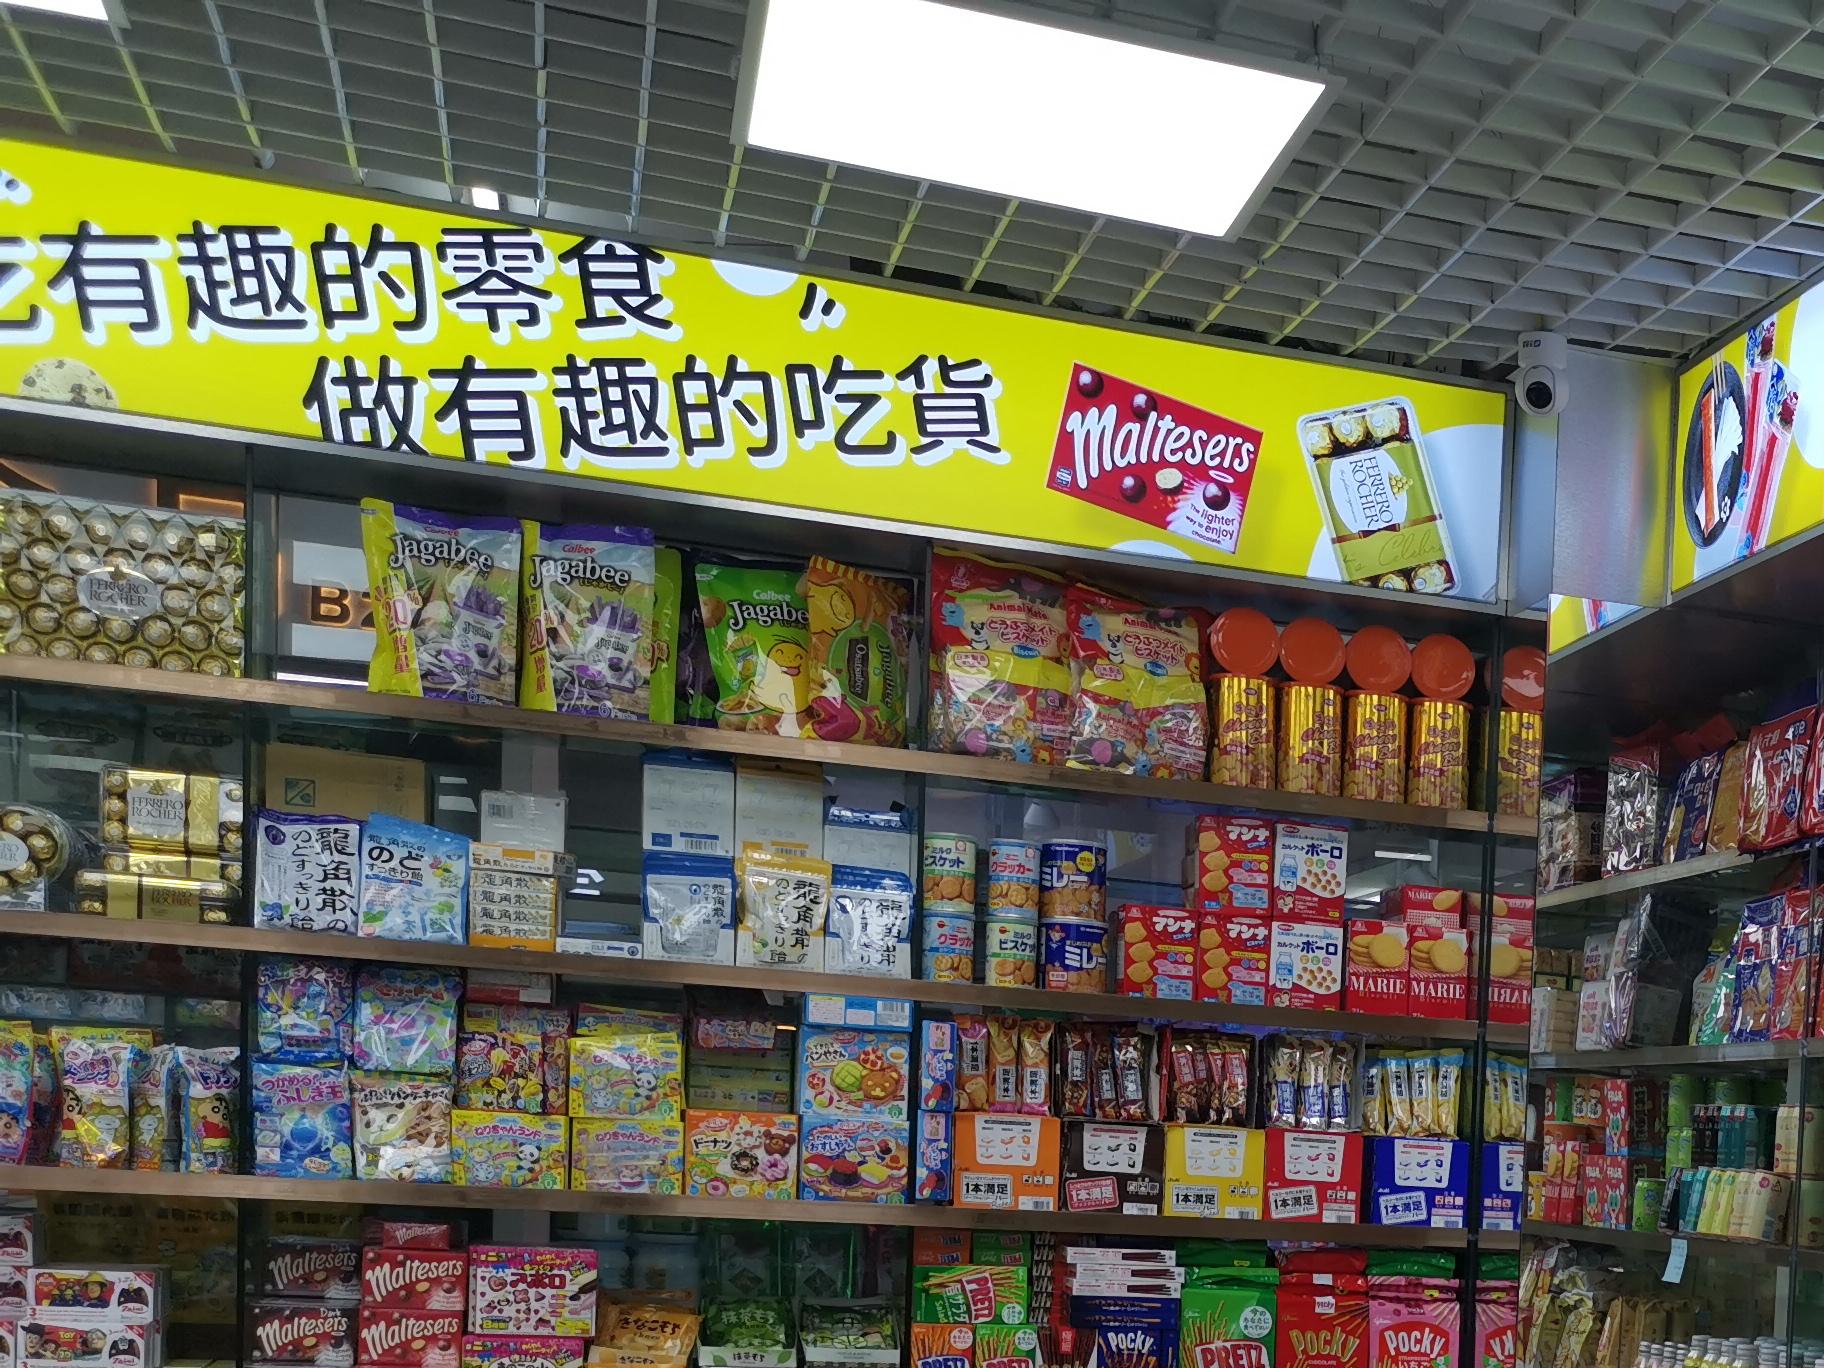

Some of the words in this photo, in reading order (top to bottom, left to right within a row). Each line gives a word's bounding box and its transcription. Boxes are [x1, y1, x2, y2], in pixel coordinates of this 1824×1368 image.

[303, 352, 1001, 464] 做有趣的吃貨
[1066, 404, 1255, 488] Maltesers
[1350, 462, 1380, 529] ROCHER
[1363, 456, 1394, 524] FERRERO
[1201, 509, 1236, 526] lighter
[1205, 523, 1234, 539] enjoy
[389, 532, 493, 572] Jagabee
[561, 543, 596, 555] Calbee
[530, 555, 630, 588] Jagabee
[752, 588, 791, 601] Calbee
[728, 599, 809, 632] Jagabe
[131, 797, 184, 811] FERRERO
[131, 806, 183, 820] ROCHER
[1226, 825, 1269, 840] マンナ
[368, 845, 425, 864] のど
[1306, 843, 1342, 859] ボーロ
[991, 861, 1033, 875] クラッカー
[1041, 865, 1089, 888] ミレー
[1153, 917, 1195, 932] マンナ
[1227, 923, 1269, 939] マンナ
[1301, 940, 1338, 955] ボーロ
[1350, 976, 1406, 996] MARIE
[1411, 980, 1465, 999] MARIE
[692, 1137, 733, 1150] ドーナツ
[963, 1183, 1011, 1196] 1本満足
[1173, 1190, 1217, 1205] 1本満足
[1271, 1195, 1317, 1211] 1本満足
[1383, 1198, 1425, 1214] 1本満足
[269, 1252, 358, 1289] Maltesers
[365, 1257, 464, 1301] Maltesers
[509, 1273, 567, 1289] アポロ
[964, 1273, 994, 1323] PRETZ
[257, 1313, 348, 1353] Maltesers
[361, 1316, 459, 1359] Maltesers
[1108, 1330, 1153, 1352] POCKY
[1385, 1326, 1446, 1358] POCKY
[1291, 1326, 1361, 1364] POCKY
